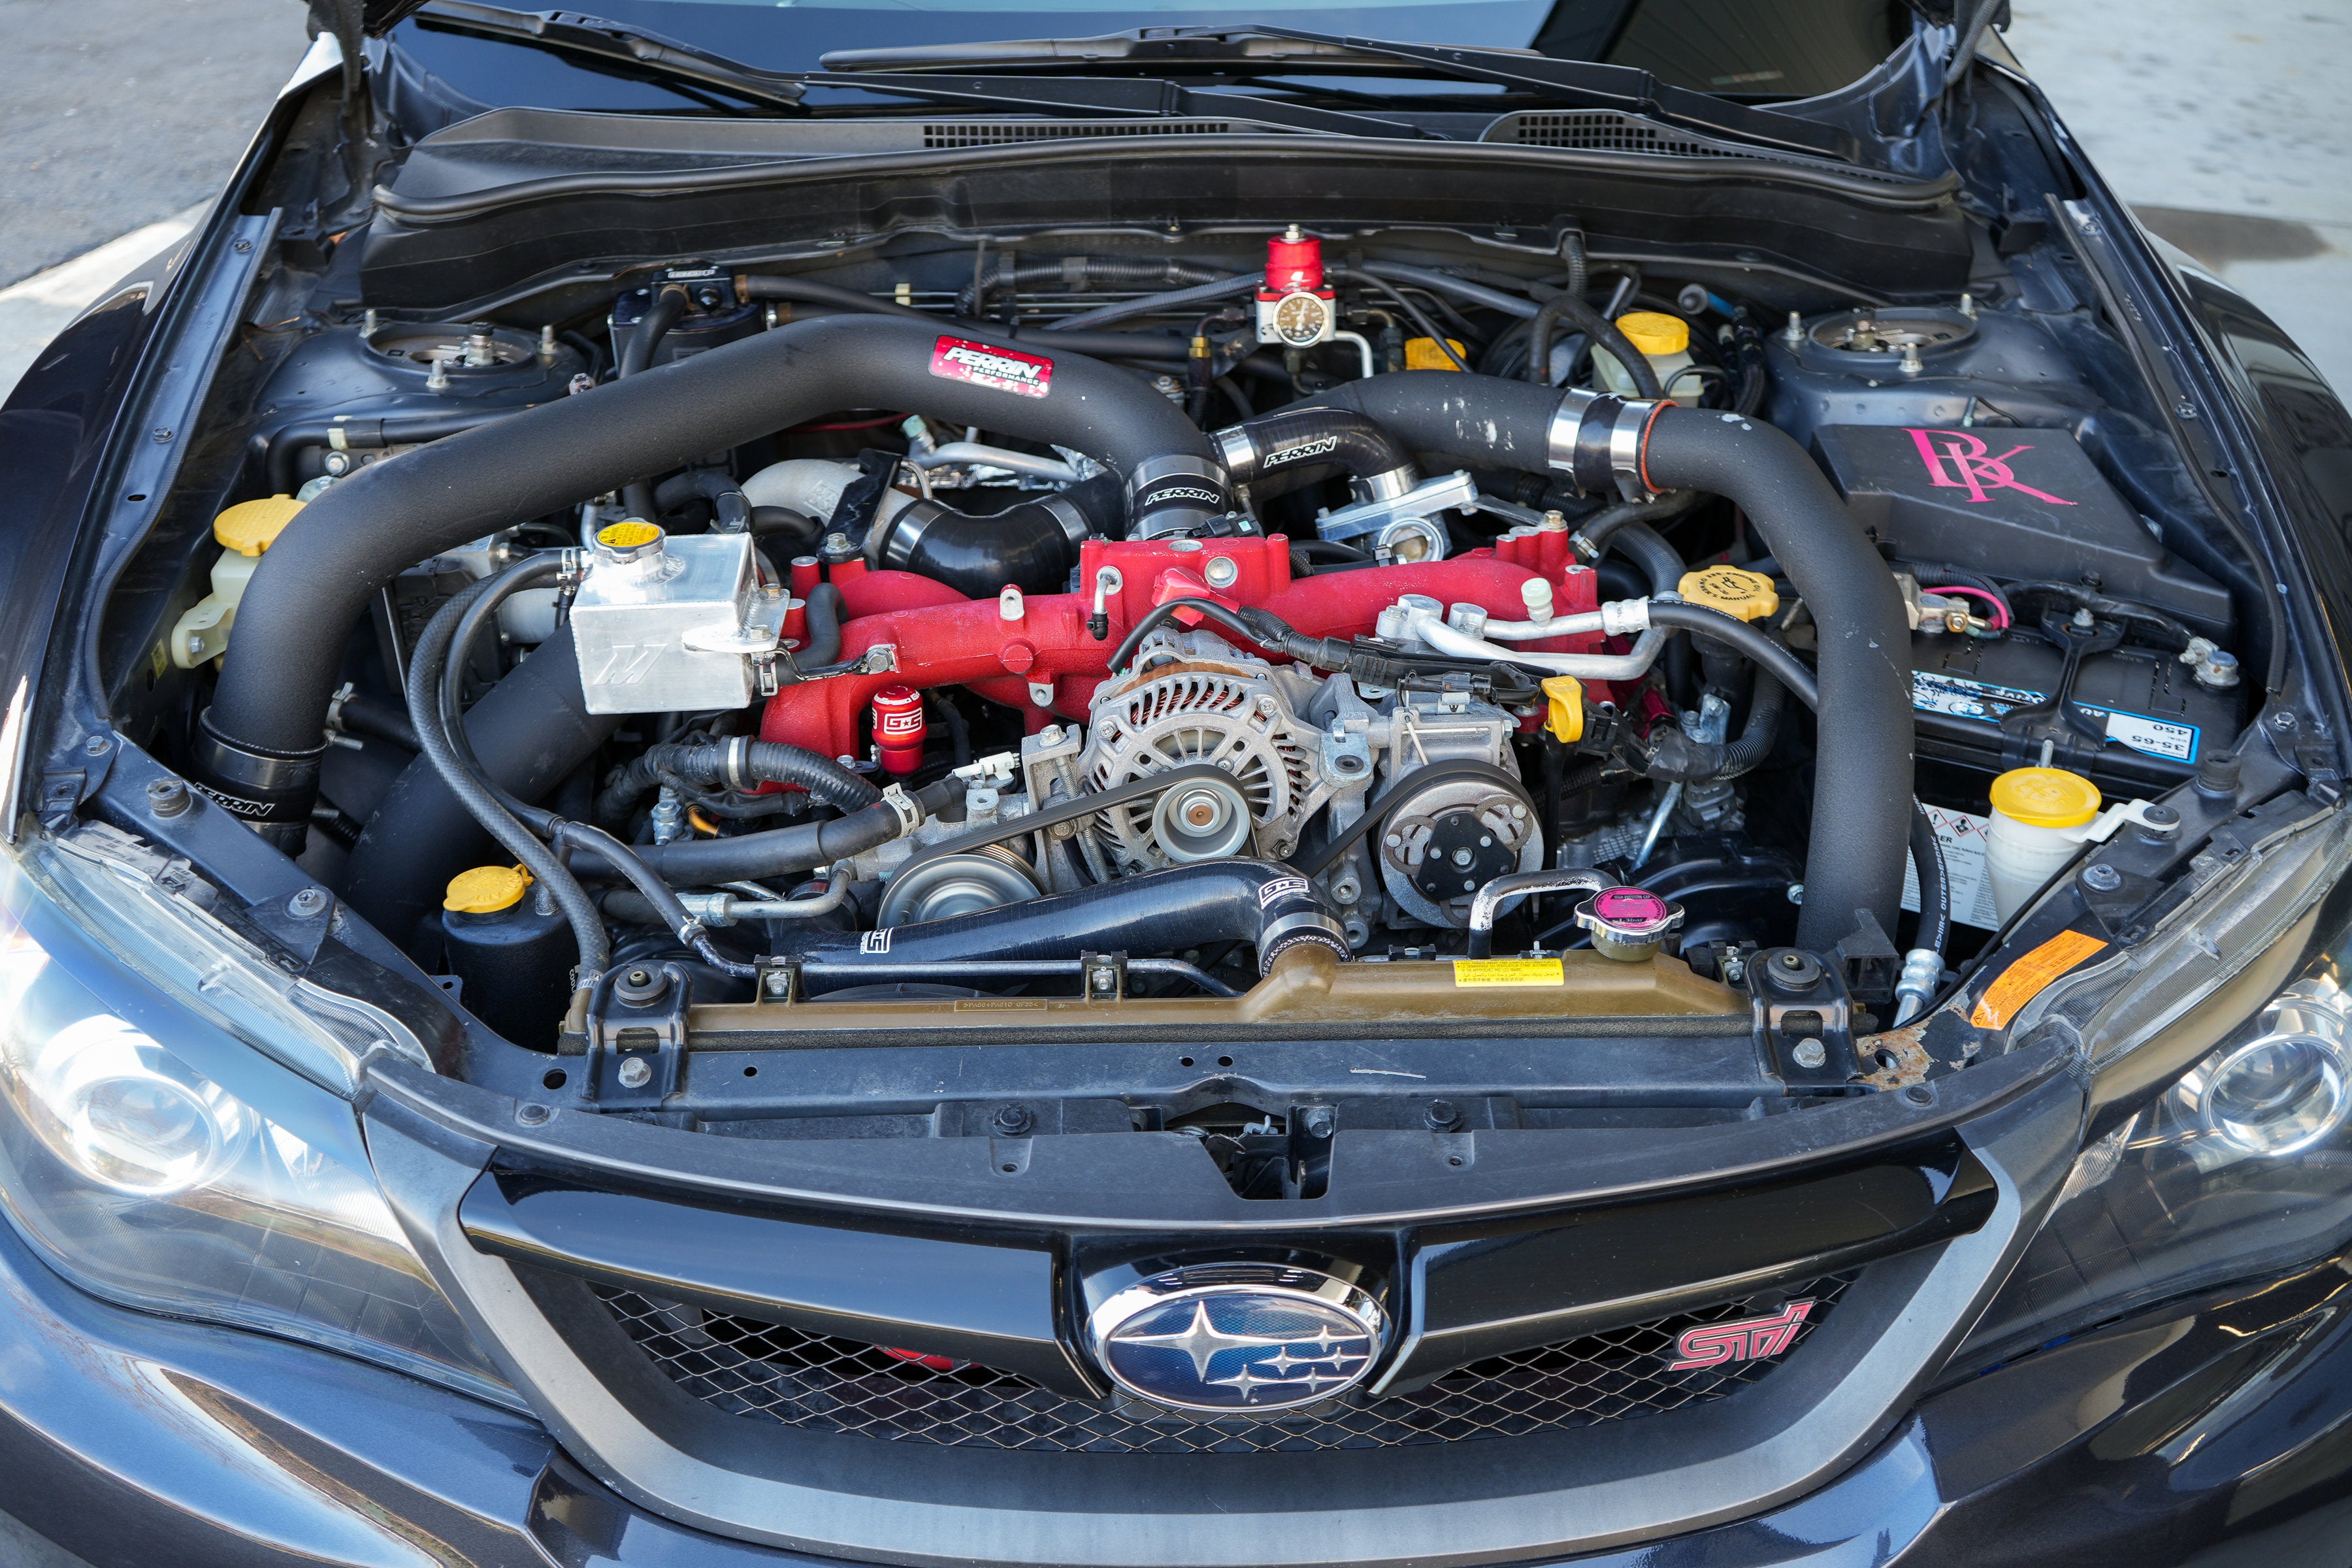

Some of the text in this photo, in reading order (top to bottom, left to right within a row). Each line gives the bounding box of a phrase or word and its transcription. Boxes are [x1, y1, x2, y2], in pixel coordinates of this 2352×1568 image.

[943, 346, 1043, 378] PERRIN
[973, 367, 1039, 385] PERFORMANCE
[1263, 436, 1337, 468] PERRIN
[1145, 487, 1220, 506] PERRIN
[2153, 724, 2188, 735] 450
[2132, 735, 2184, 751] 35-65
[1652, 900, 1662, 919] DANGER
